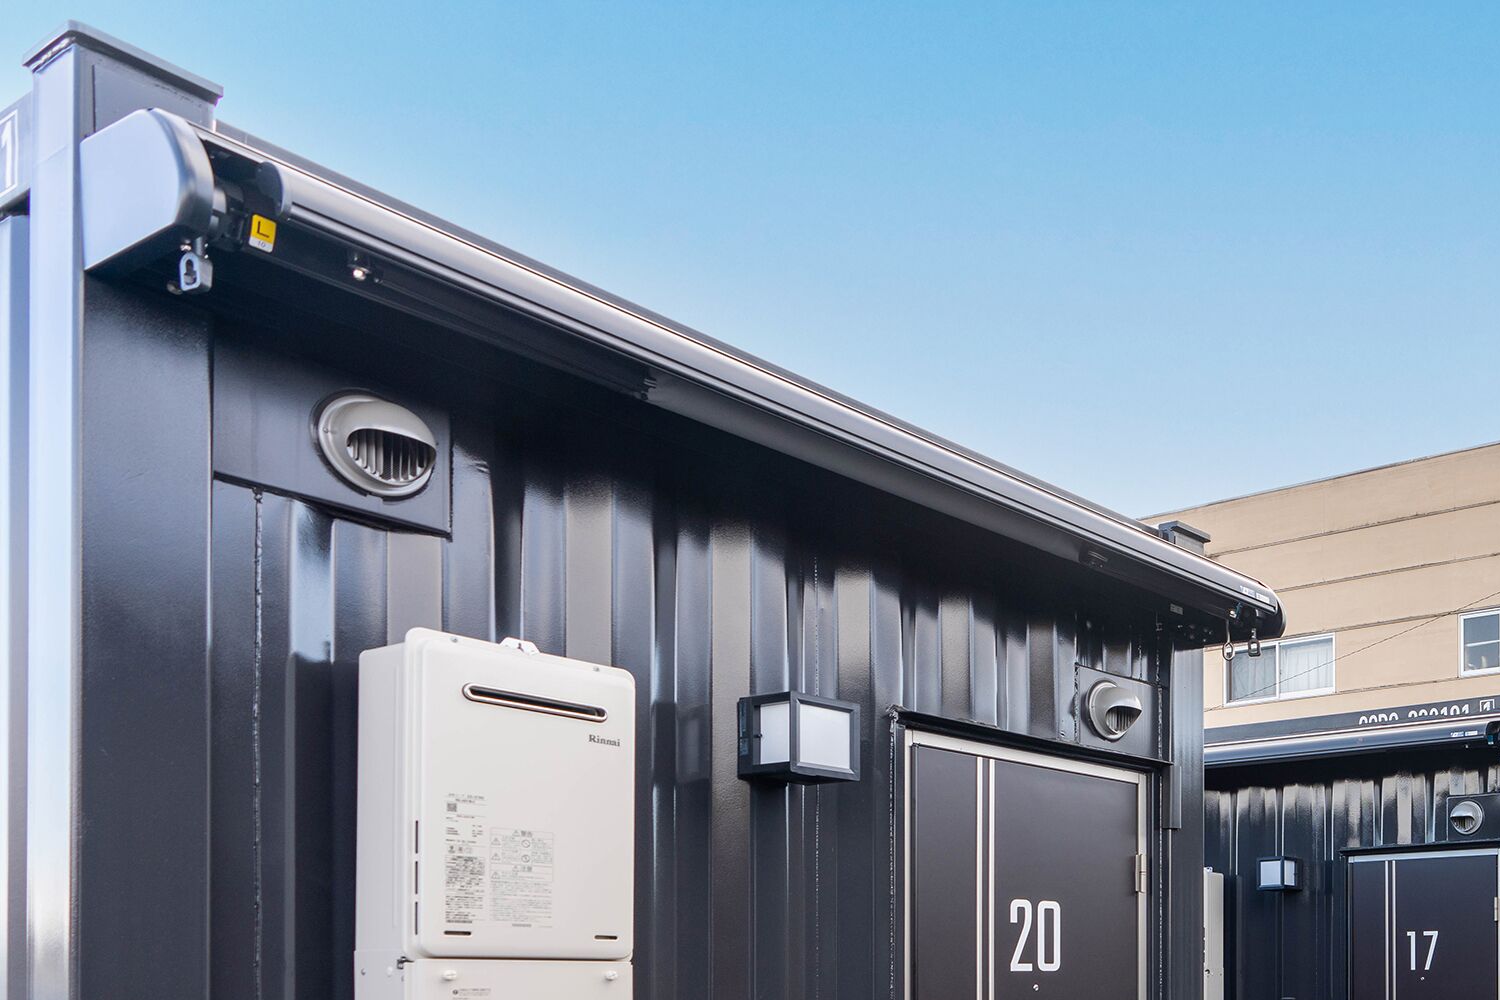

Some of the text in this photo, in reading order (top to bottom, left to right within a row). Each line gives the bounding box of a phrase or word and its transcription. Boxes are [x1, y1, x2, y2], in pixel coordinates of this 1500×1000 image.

[588, 734, 620, 747] Rinnai
[1010, 899, 1061, 972] 20
[1406, 930, 1438, 970] 17
